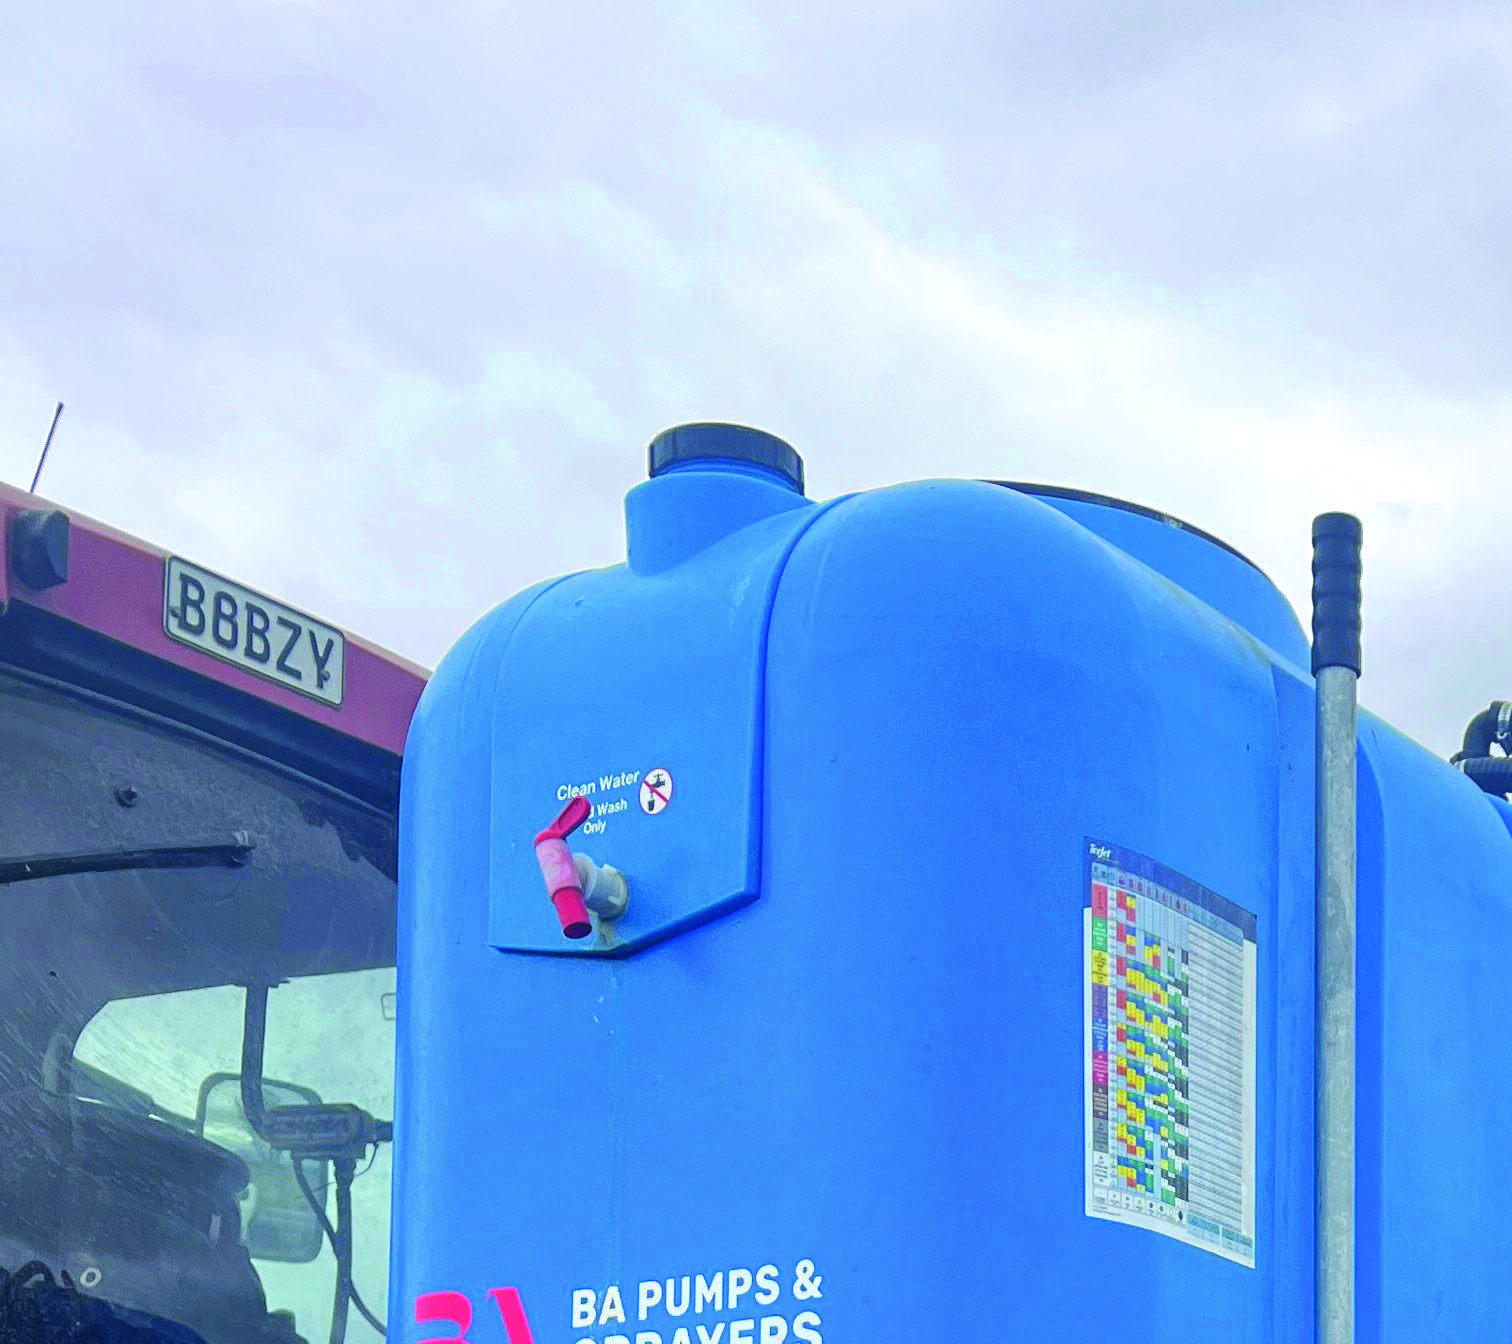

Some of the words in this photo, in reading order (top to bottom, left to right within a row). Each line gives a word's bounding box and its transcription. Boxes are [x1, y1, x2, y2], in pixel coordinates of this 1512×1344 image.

[557, 781, 596, 801] Clean
[599, 771, 640, 792] Water
[597, 798, 628, 817] Wash
[583, 820, 606, 835] Only
[571, 1285, 626, 1329] BA
[638, 1264, 780, 1321] PUMPS
[792, 1258, 823, 1300] &
